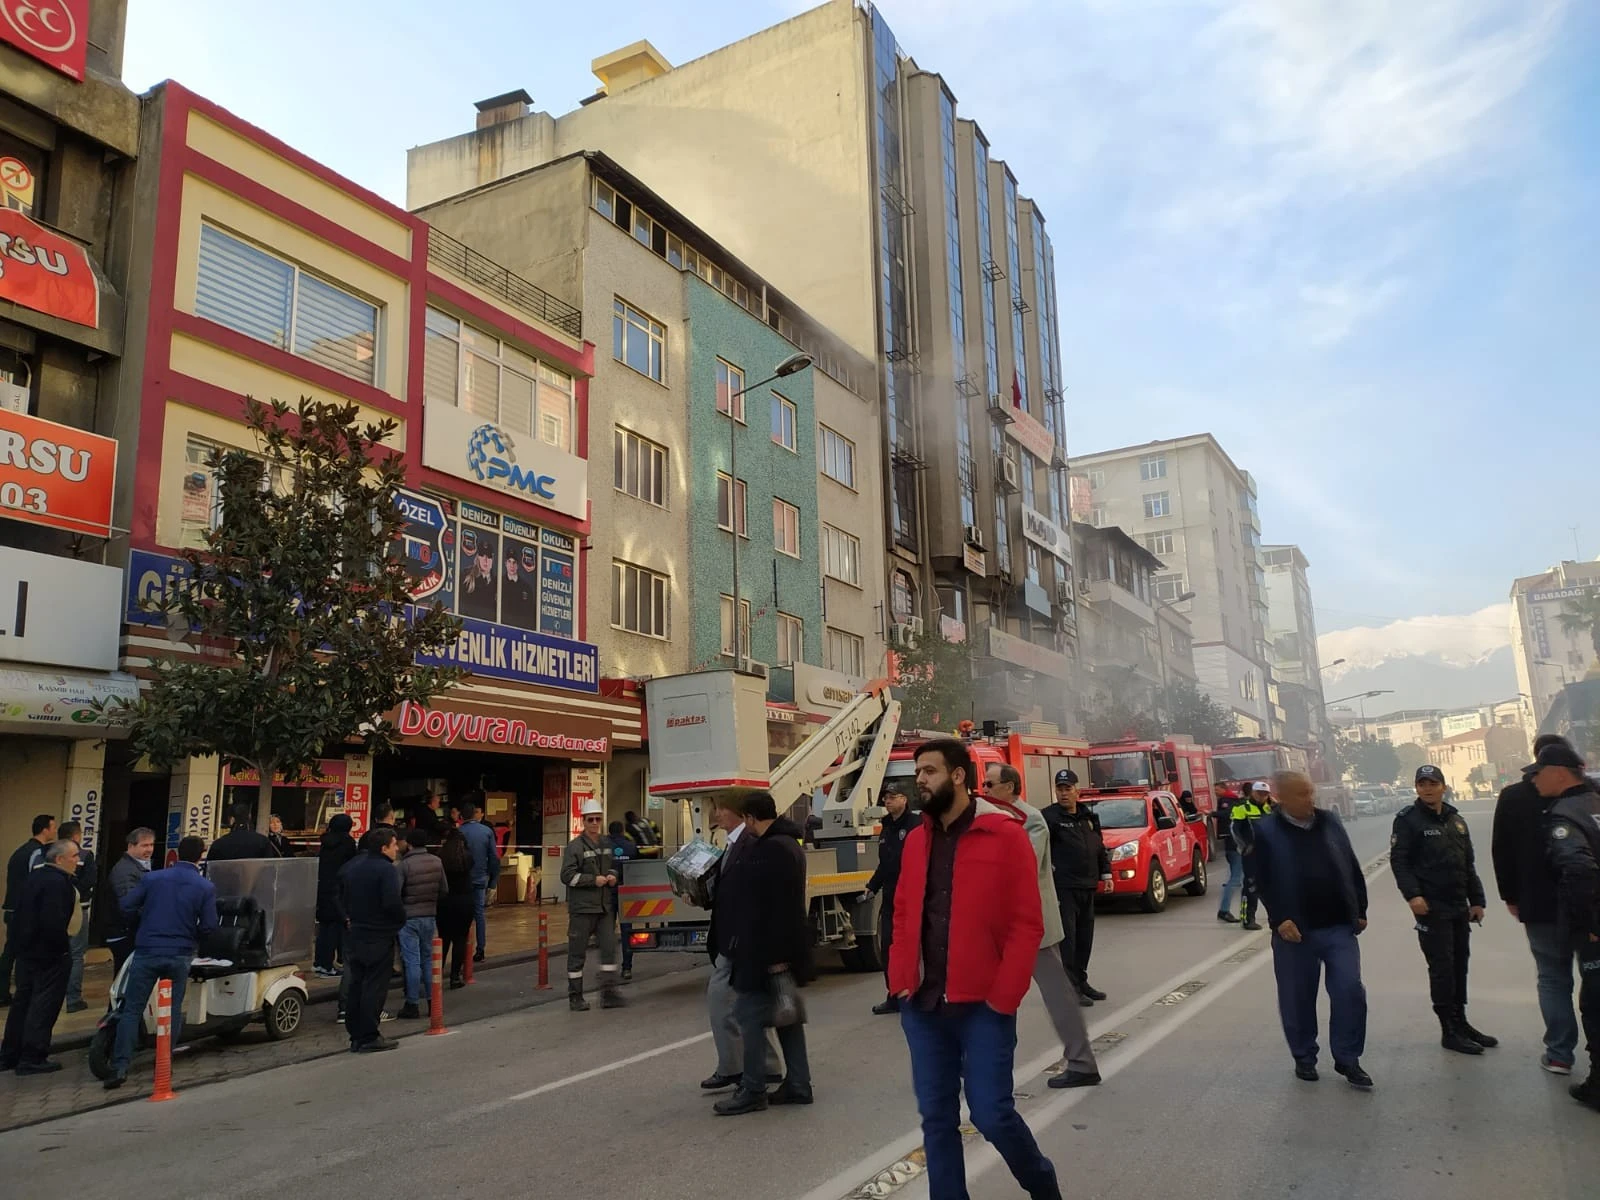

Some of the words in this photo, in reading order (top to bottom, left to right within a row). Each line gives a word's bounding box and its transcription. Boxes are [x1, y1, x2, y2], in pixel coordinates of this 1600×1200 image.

[487, 457, 556, 500] PMC
[398, 499, 436, 526] ÖZEL
[503, 520, 537, 538] GÜVENLİK
[542, 556, 572, 578] TMG
[542, 577, 572, 594] DENİZLİ
[541, 591, 571, 608] GÜVENLİK
[511, 634, 595, 684] HİZMETLERİ
[401, 700, 528, 746] Doyuran
[526, 731, 608, 753] Pastanesi
[352, 786, 362, 801] 5
